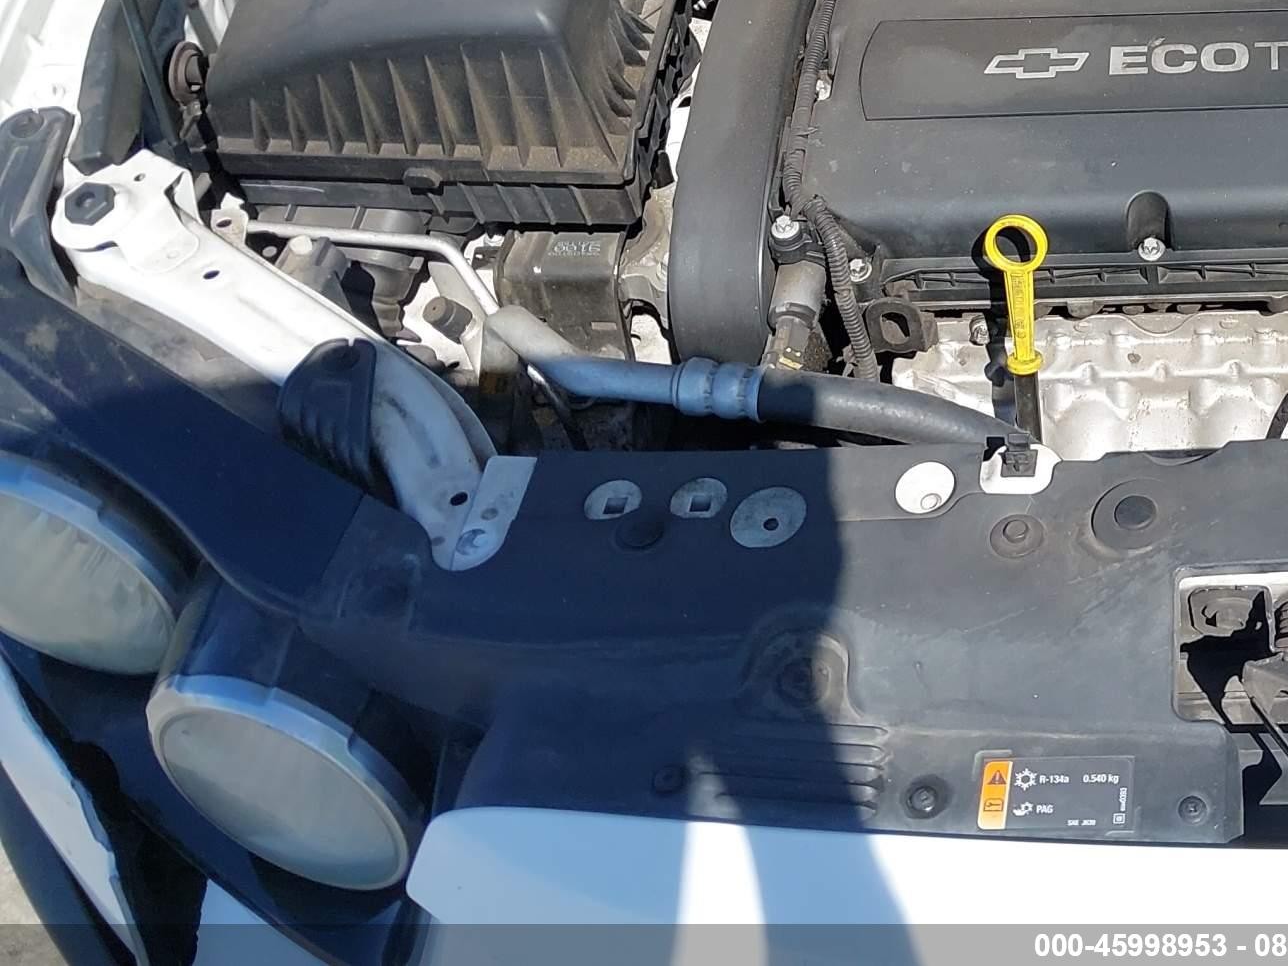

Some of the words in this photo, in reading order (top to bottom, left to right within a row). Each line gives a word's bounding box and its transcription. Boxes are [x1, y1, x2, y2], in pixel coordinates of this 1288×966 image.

[1039, 775, 1070, 784] R-134a
[1083, 774, 1107, 783] 0.540
[1108, 774, 1120, 784] kg
[1036, 804, 1054, 814] PAG
